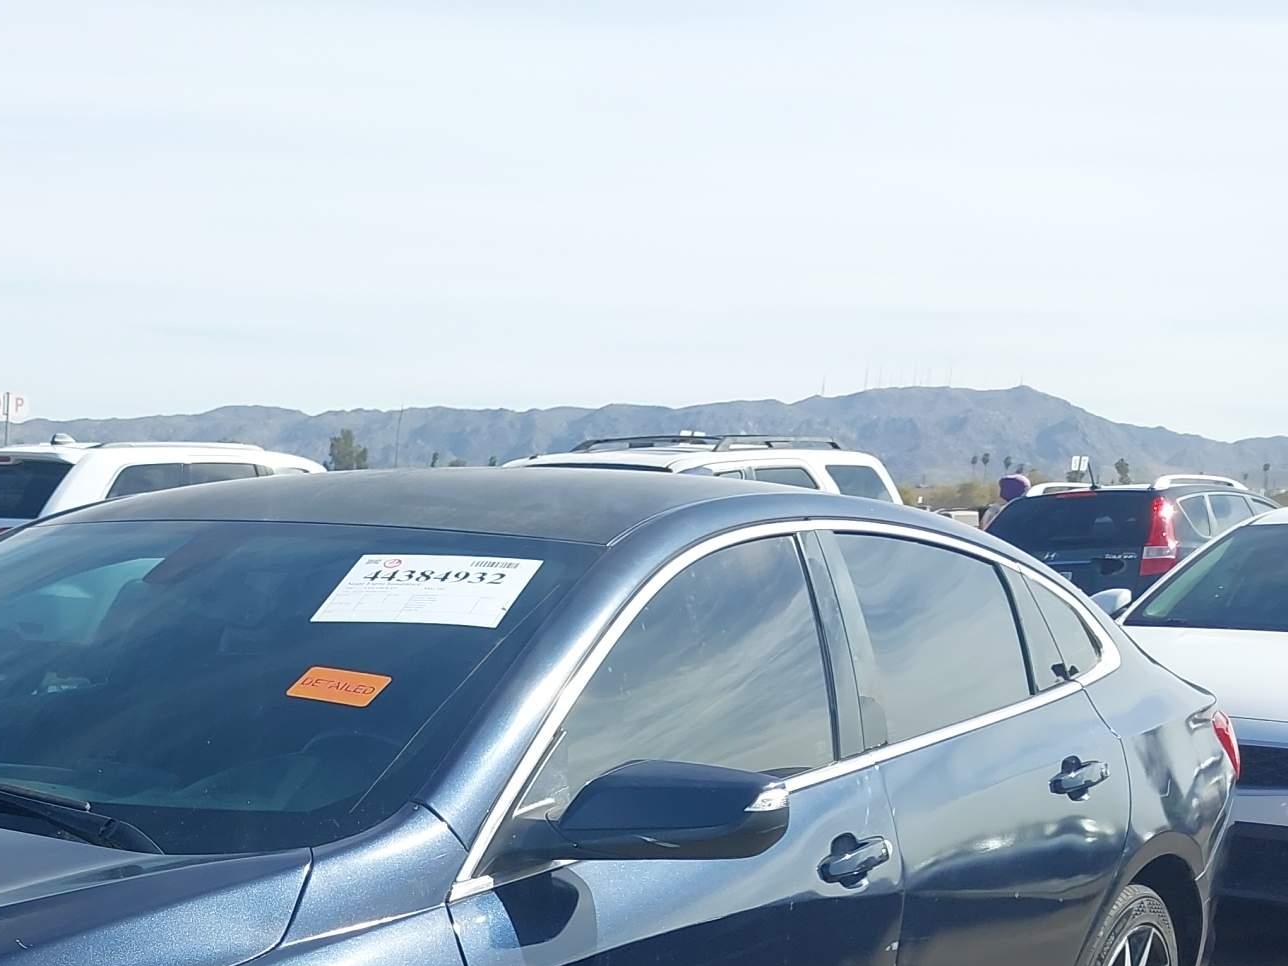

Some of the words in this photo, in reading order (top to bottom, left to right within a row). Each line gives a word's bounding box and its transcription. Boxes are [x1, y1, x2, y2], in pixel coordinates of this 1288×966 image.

[15, 397, 24, 413] P
[363, 569, 507, 585] 44384932
[300, 677, 377, 696] DETAILED
